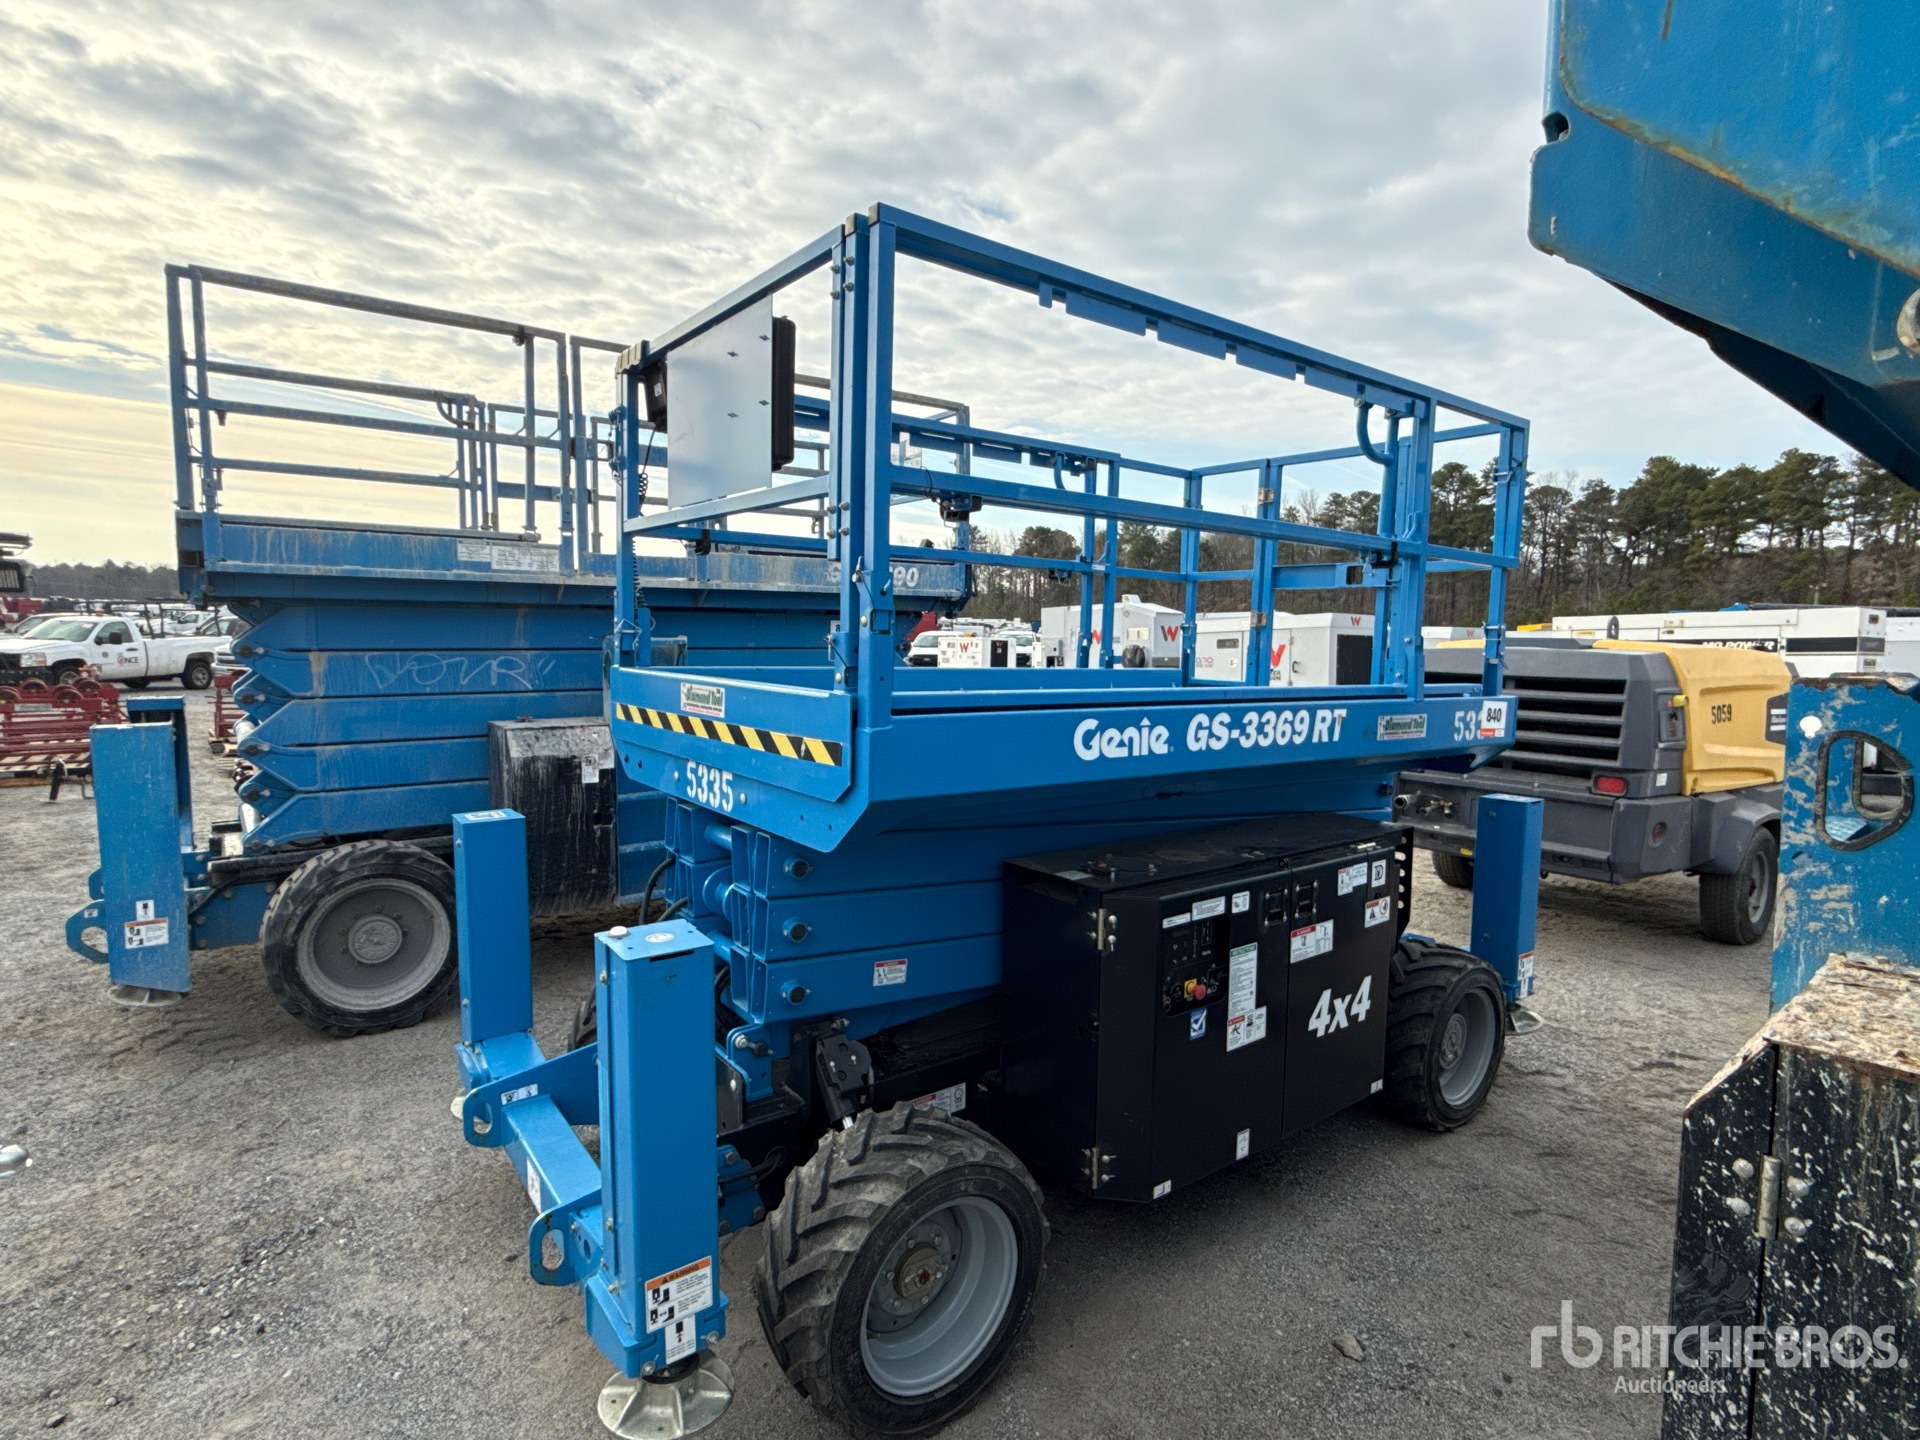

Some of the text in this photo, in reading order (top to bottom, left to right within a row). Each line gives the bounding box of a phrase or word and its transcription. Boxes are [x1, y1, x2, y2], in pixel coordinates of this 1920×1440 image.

[1073, 708, 1348, 761] Genie GS-3369 RT
[1486, 707, 1502, 723] 840
[1711, 703, 1733, 725] 5059
[686, 760, 734, 813] 5335
[1307, 975, 1373, 1038] 4x4
